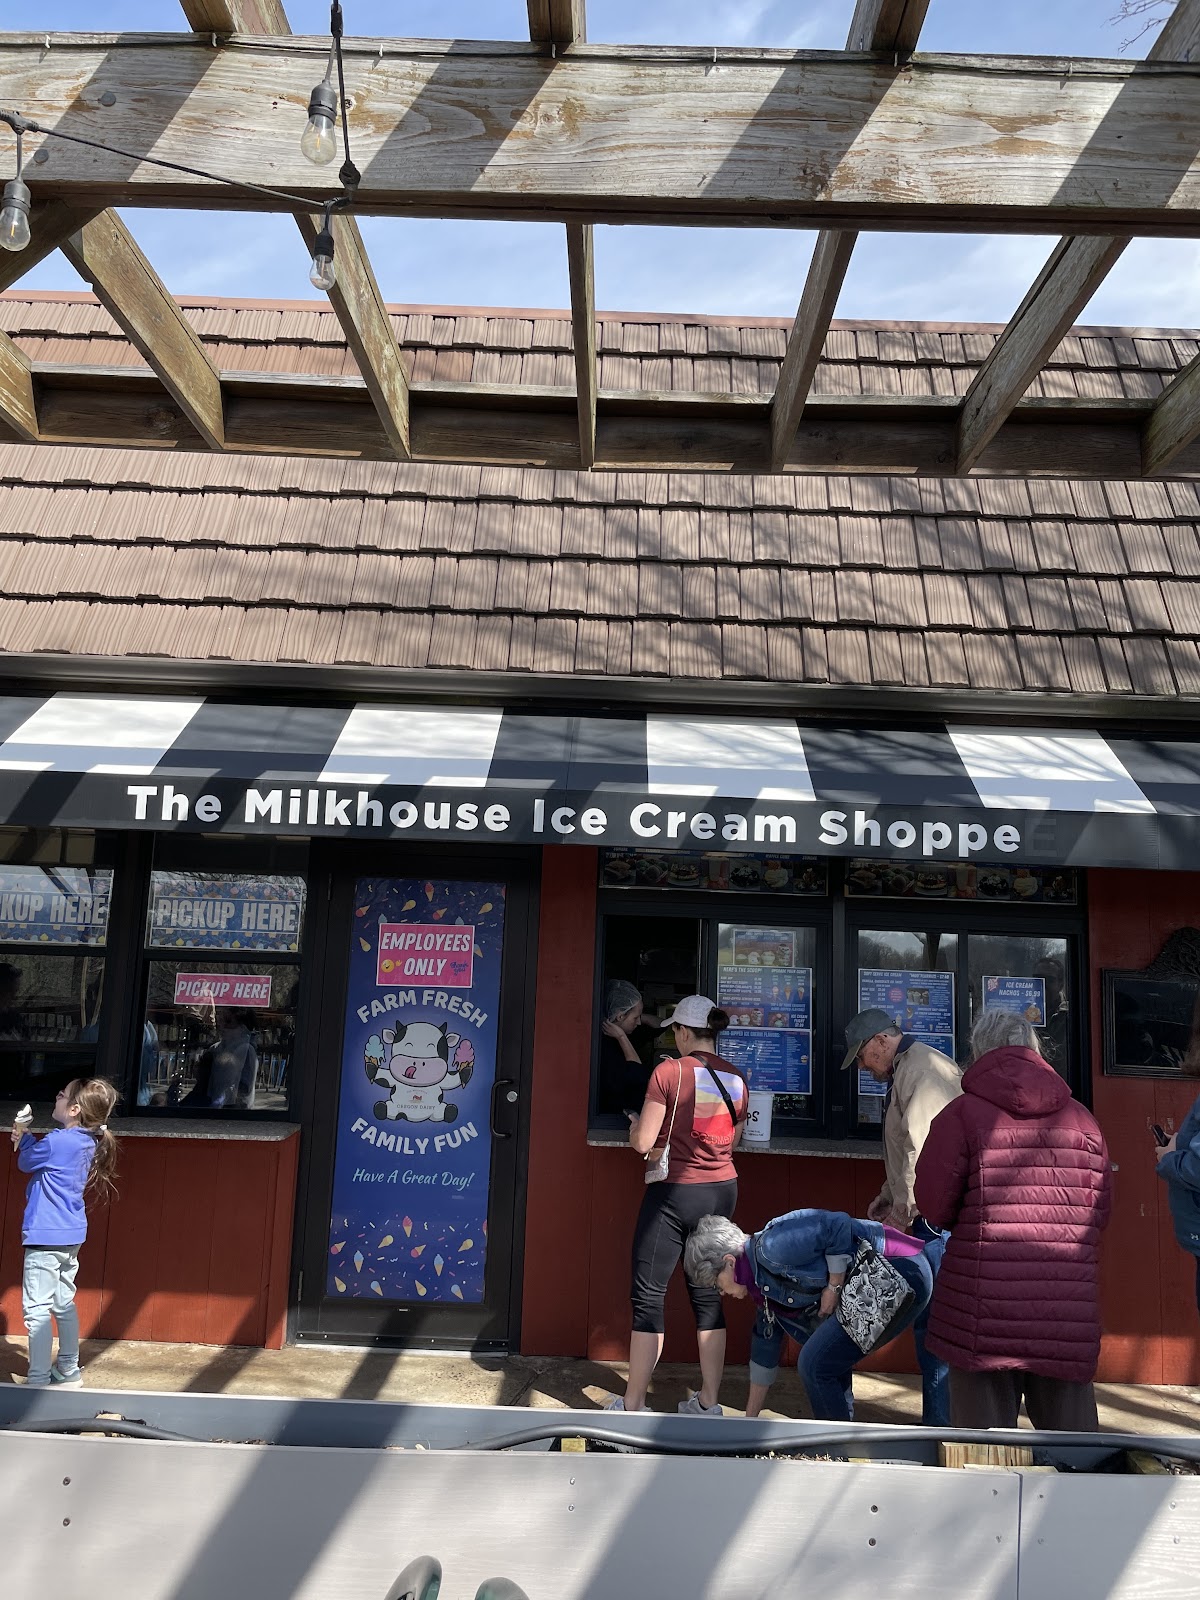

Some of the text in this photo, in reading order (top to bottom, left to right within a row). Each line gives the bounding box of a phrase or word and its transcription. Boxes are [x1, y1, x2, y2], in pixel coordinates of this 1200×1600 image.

[127, 785, 1021, 858] The Milkhouse Ice Cream Shoppe
[0, 893, 106, 925] KUP HERE
[156, 899, 297, 932] PICKUP HERE
[380, 932, 471, 952] EMPLOYEES
[403, 957, 448, 977] ONLY
[176, 980, 270, 999] PICKUP HERE
[356, 989, 489, 1029] FARM FRESH
[350, 1117, 479, 1155] FAMILY FUN
[352, 1167, 476, 1192] Have A Great Day!
